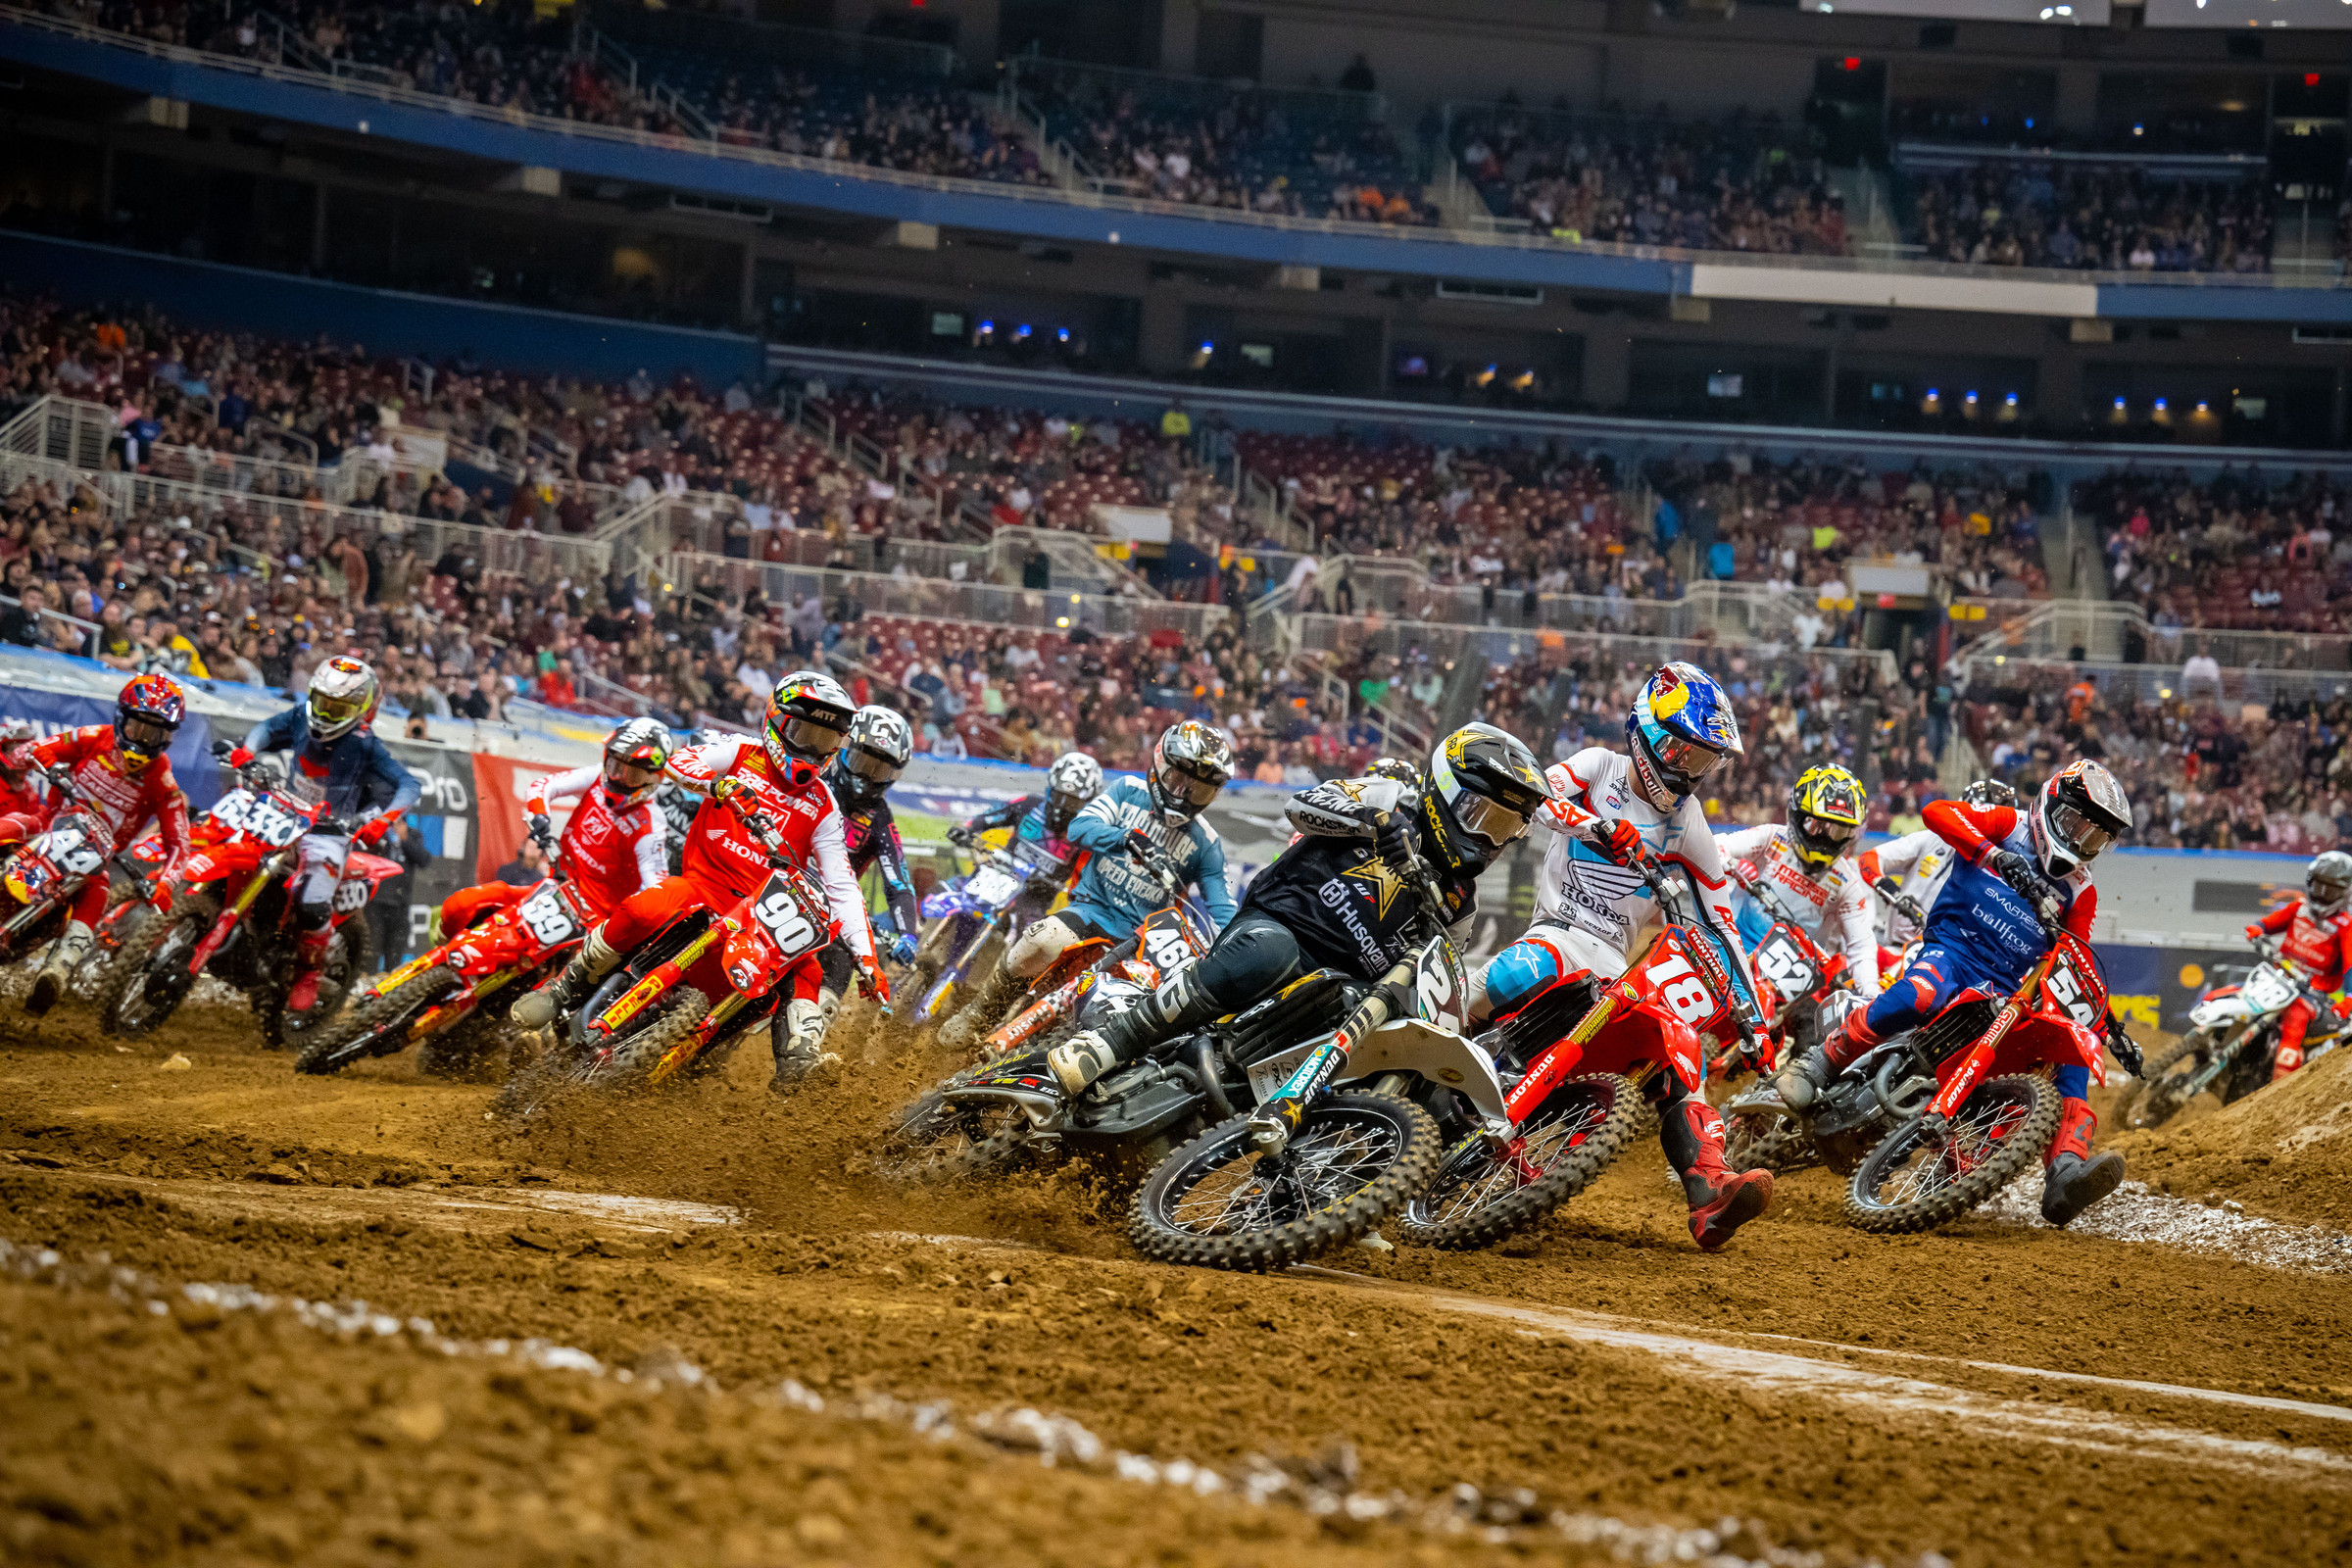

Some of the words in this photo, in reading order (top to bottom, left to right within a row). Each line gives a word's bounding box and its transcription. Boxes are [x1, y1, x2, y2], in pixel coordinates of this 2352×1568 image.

[811, 709, 838, 723] MTF
[765, 782, 819, 821] POWER
[1609, 783, 1631, 806] SHOWA
[242, 799, 305, 848] 330
[49, 828, 104, 875] 44
[567, 833, 607, 874] HONDA
[721, 836, 772, 870] HON
[1562, 881, 1631, 927] HONDA
[1773, 871, 1825, 907] RACING
[1780, 863, 1831, 900] MOOSE
[521, 893, 573, 945] 39
[755, 892, 815, 954] 90
[1335, 900, 1392, 974] Husqvarn
[1584, 919, 1612, 936] DUNLOP
[1971, 903, 2034, 956] bullfrog
[1690, 932, 1727, 982] RENTHAL
[1757, 938, 1815, 1003] 52
[2069, 937, 2106, 996] RENTHAL
[1645, 953, 1716, 1025] 18
[2045, 966, 2096, 1028] 54
[1576, 1004, 1613, 1045] Connection
[1584, 1014, 1610, 1046] Factory
[1287, 1055, 1322, 1095] MOTOREX
[1508, 1052, 1556, 1105] DUNLOP
[1946, 1066, 1975, 1109] DUNLOP
